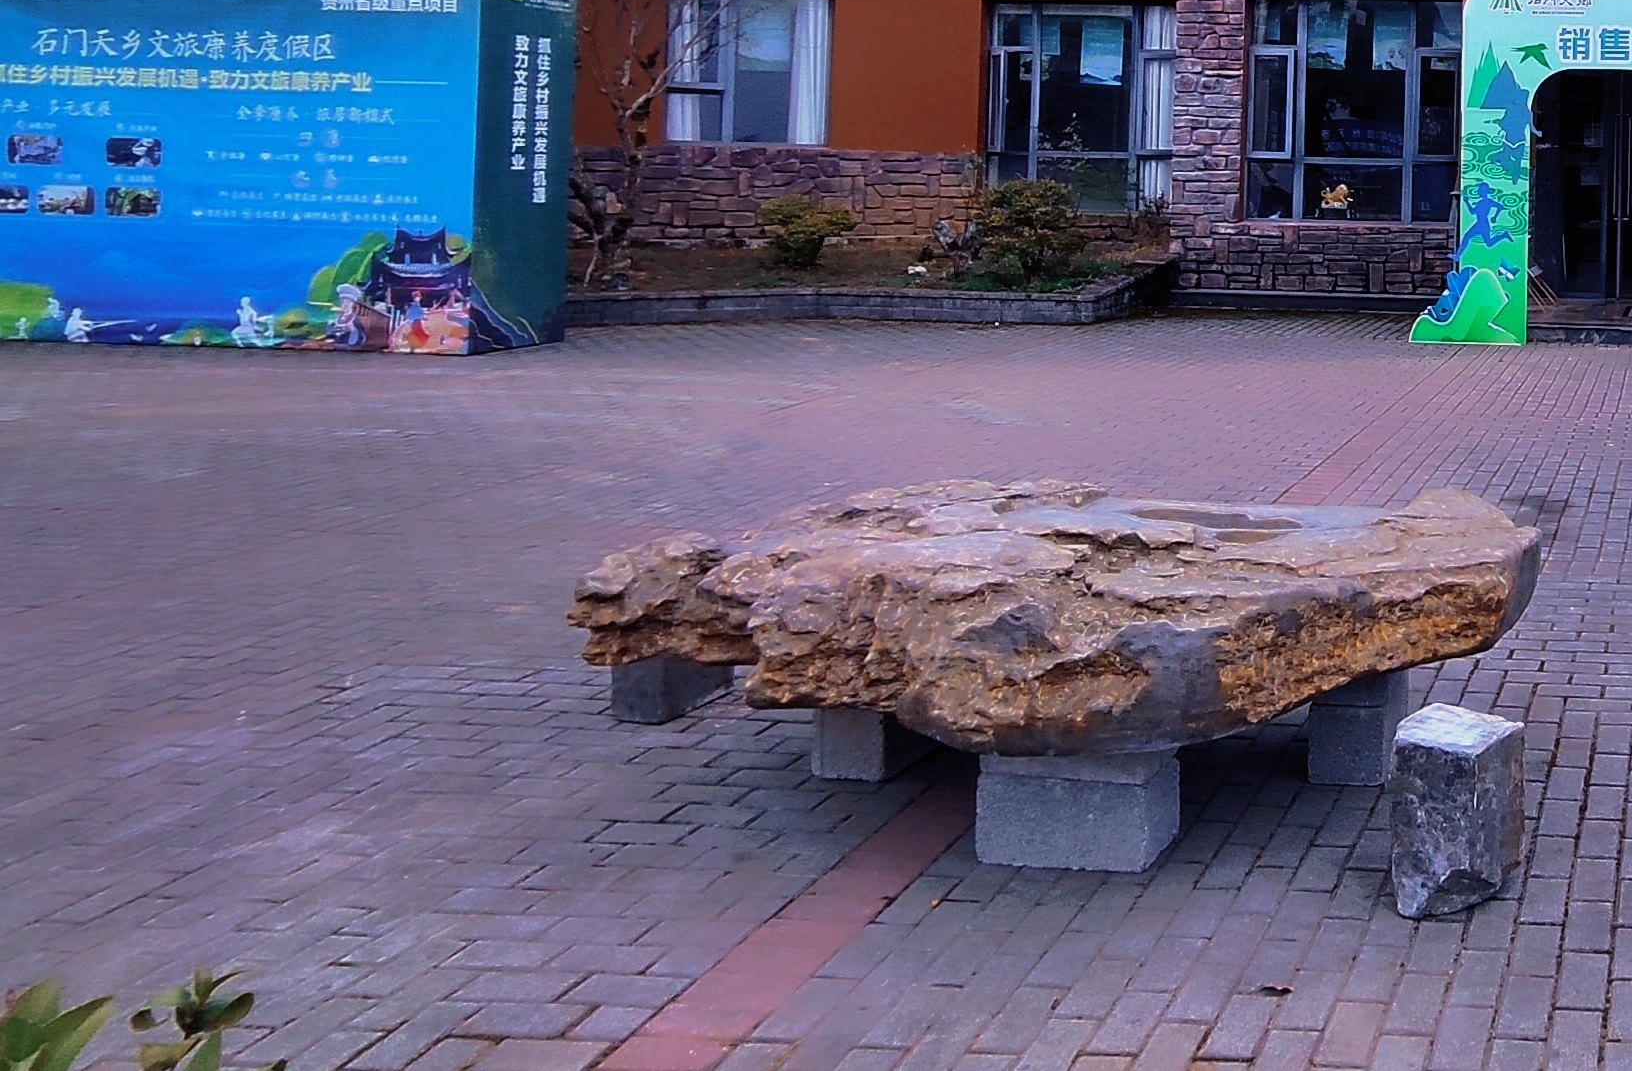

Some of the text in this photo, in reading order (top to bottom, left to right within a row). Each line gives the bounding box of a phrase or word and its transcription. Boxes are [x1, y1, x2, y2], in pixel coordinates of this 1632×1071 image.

[31, 27, 336, 63] 石门天乡文旅康养度假区
[510, 34, 530, 171] 致力文旅康养产业
[531, 37, 552, 204] 抓住乡村振兴发展机遇
